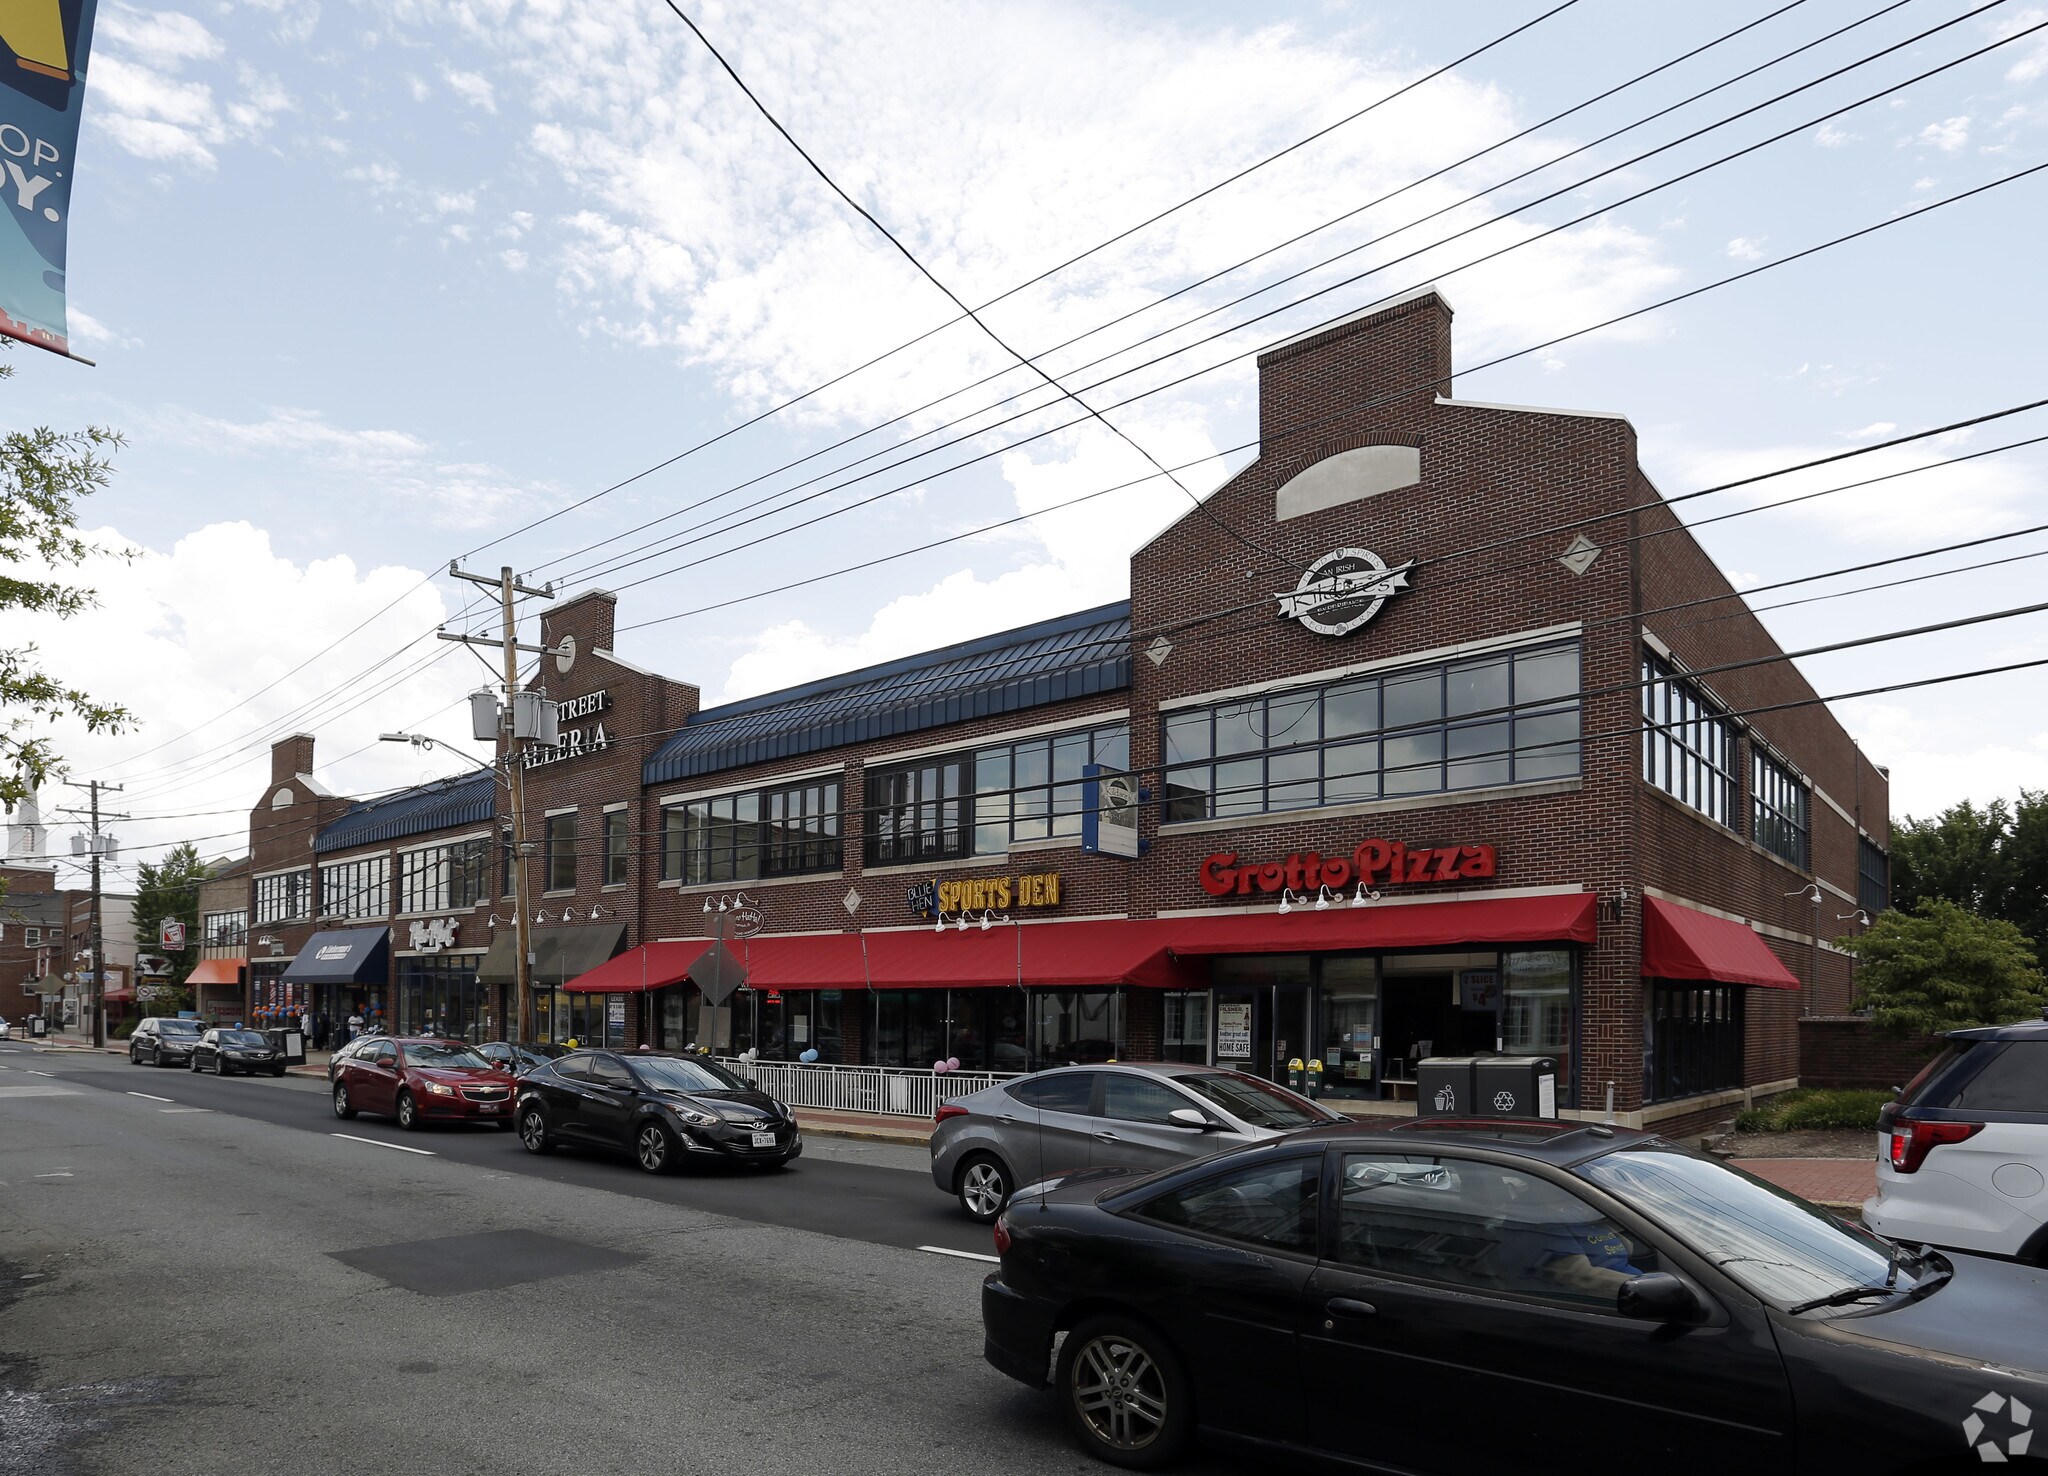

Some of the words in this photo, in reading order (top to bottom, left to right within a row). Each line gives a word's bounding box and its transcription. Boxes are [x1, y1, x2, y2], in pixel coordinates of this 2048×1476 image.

[1351, 549, 1380, 567] SPIRITS
[1335, 563, 1356, 573] IRISH
[1352, 602, 1380, 627] CRAIC
[1304, 617, 1327, 633] CEOL
[557, 690, 606, 721] TREET
[504, 722, 608, 774] ALLERIA
[1200, 852, 1350, 896] Grotto
[1354, 838, 1496, 886] Pizza
[907, 881, 932, 900] BLUE
[938, 876, 1011, 912] SPORTS
[1018, 873, 1060, 906] DEN
[911, 896, 933, 911] HEN
[1219, 1043, 1234, 1051] HOME
[1235, 1043, 1249, 1052] SAFE
